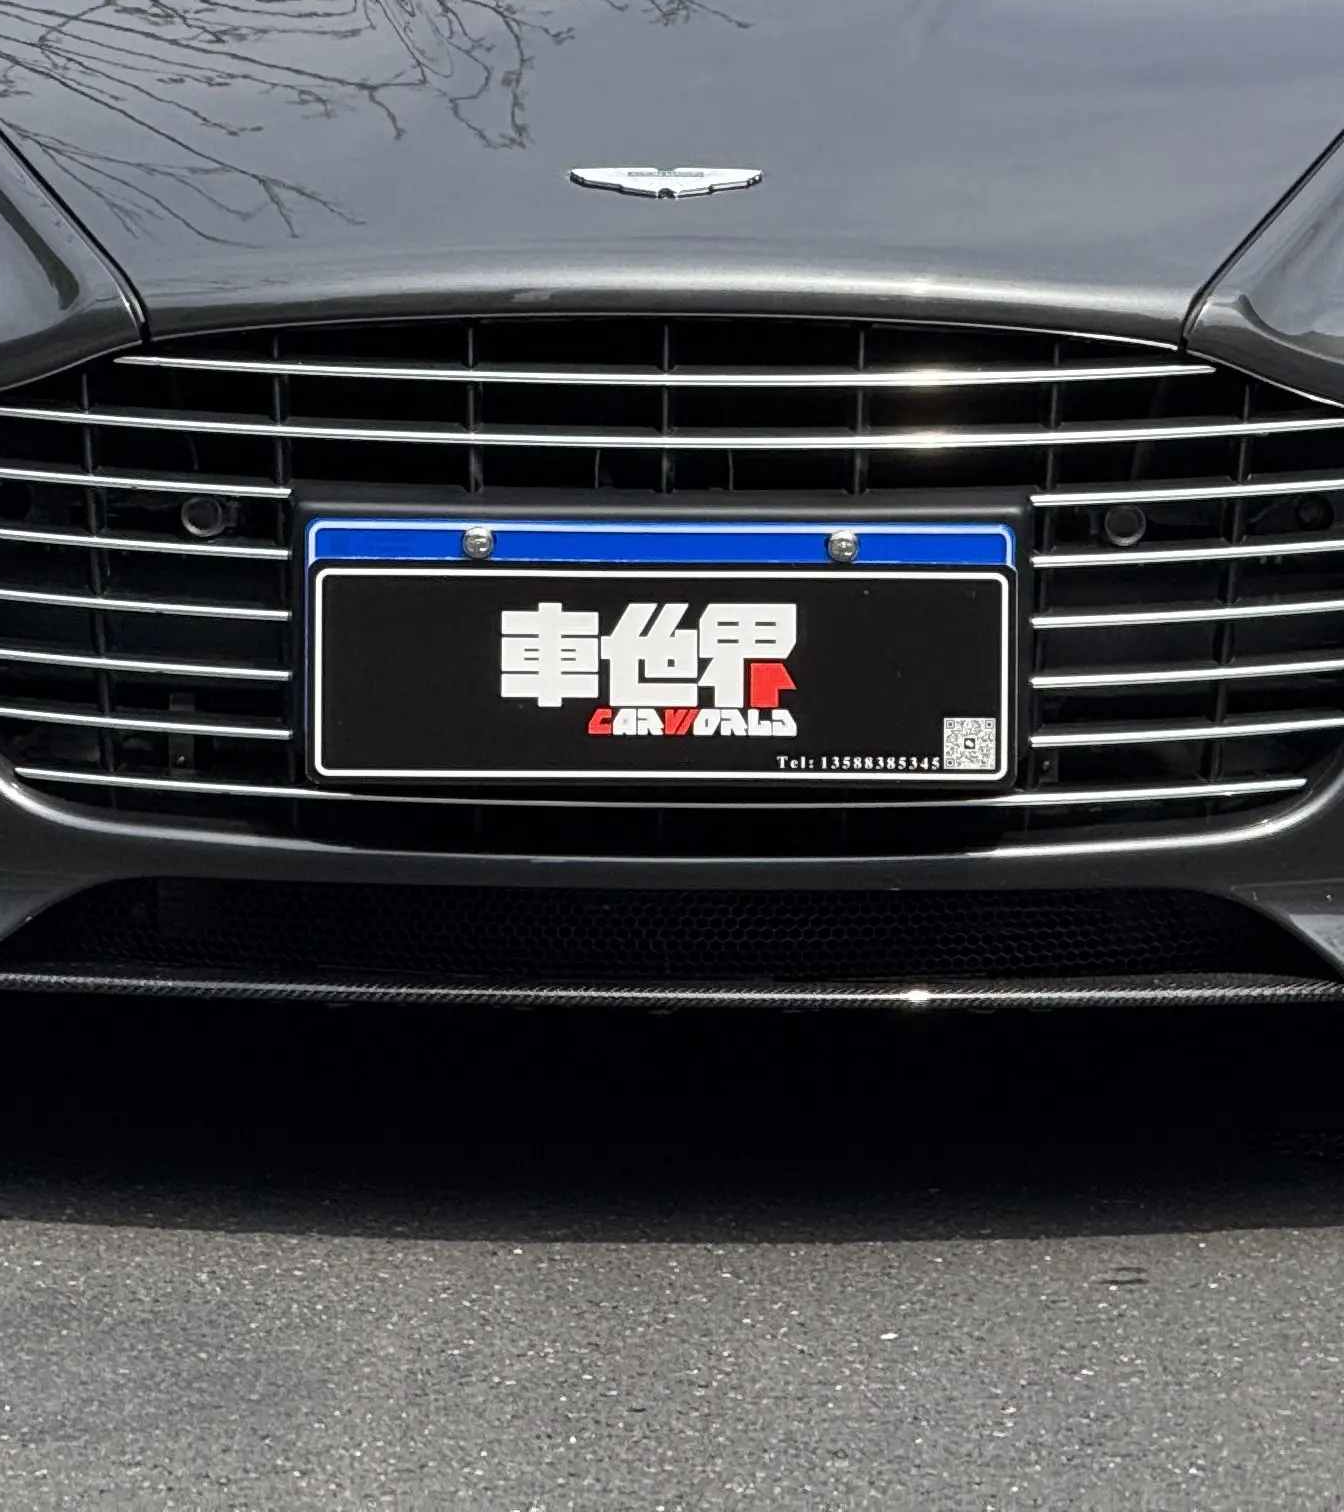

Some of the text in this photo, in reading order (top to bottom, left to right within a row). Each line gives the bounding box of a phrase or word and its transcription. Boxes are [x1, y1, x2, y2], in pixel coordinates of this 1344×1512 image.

[500, 602, 798, 709] 車世界
[587, 707, 798, 737] CARWORLD
[776, 755, 941, 771] Tel: 13588385345
